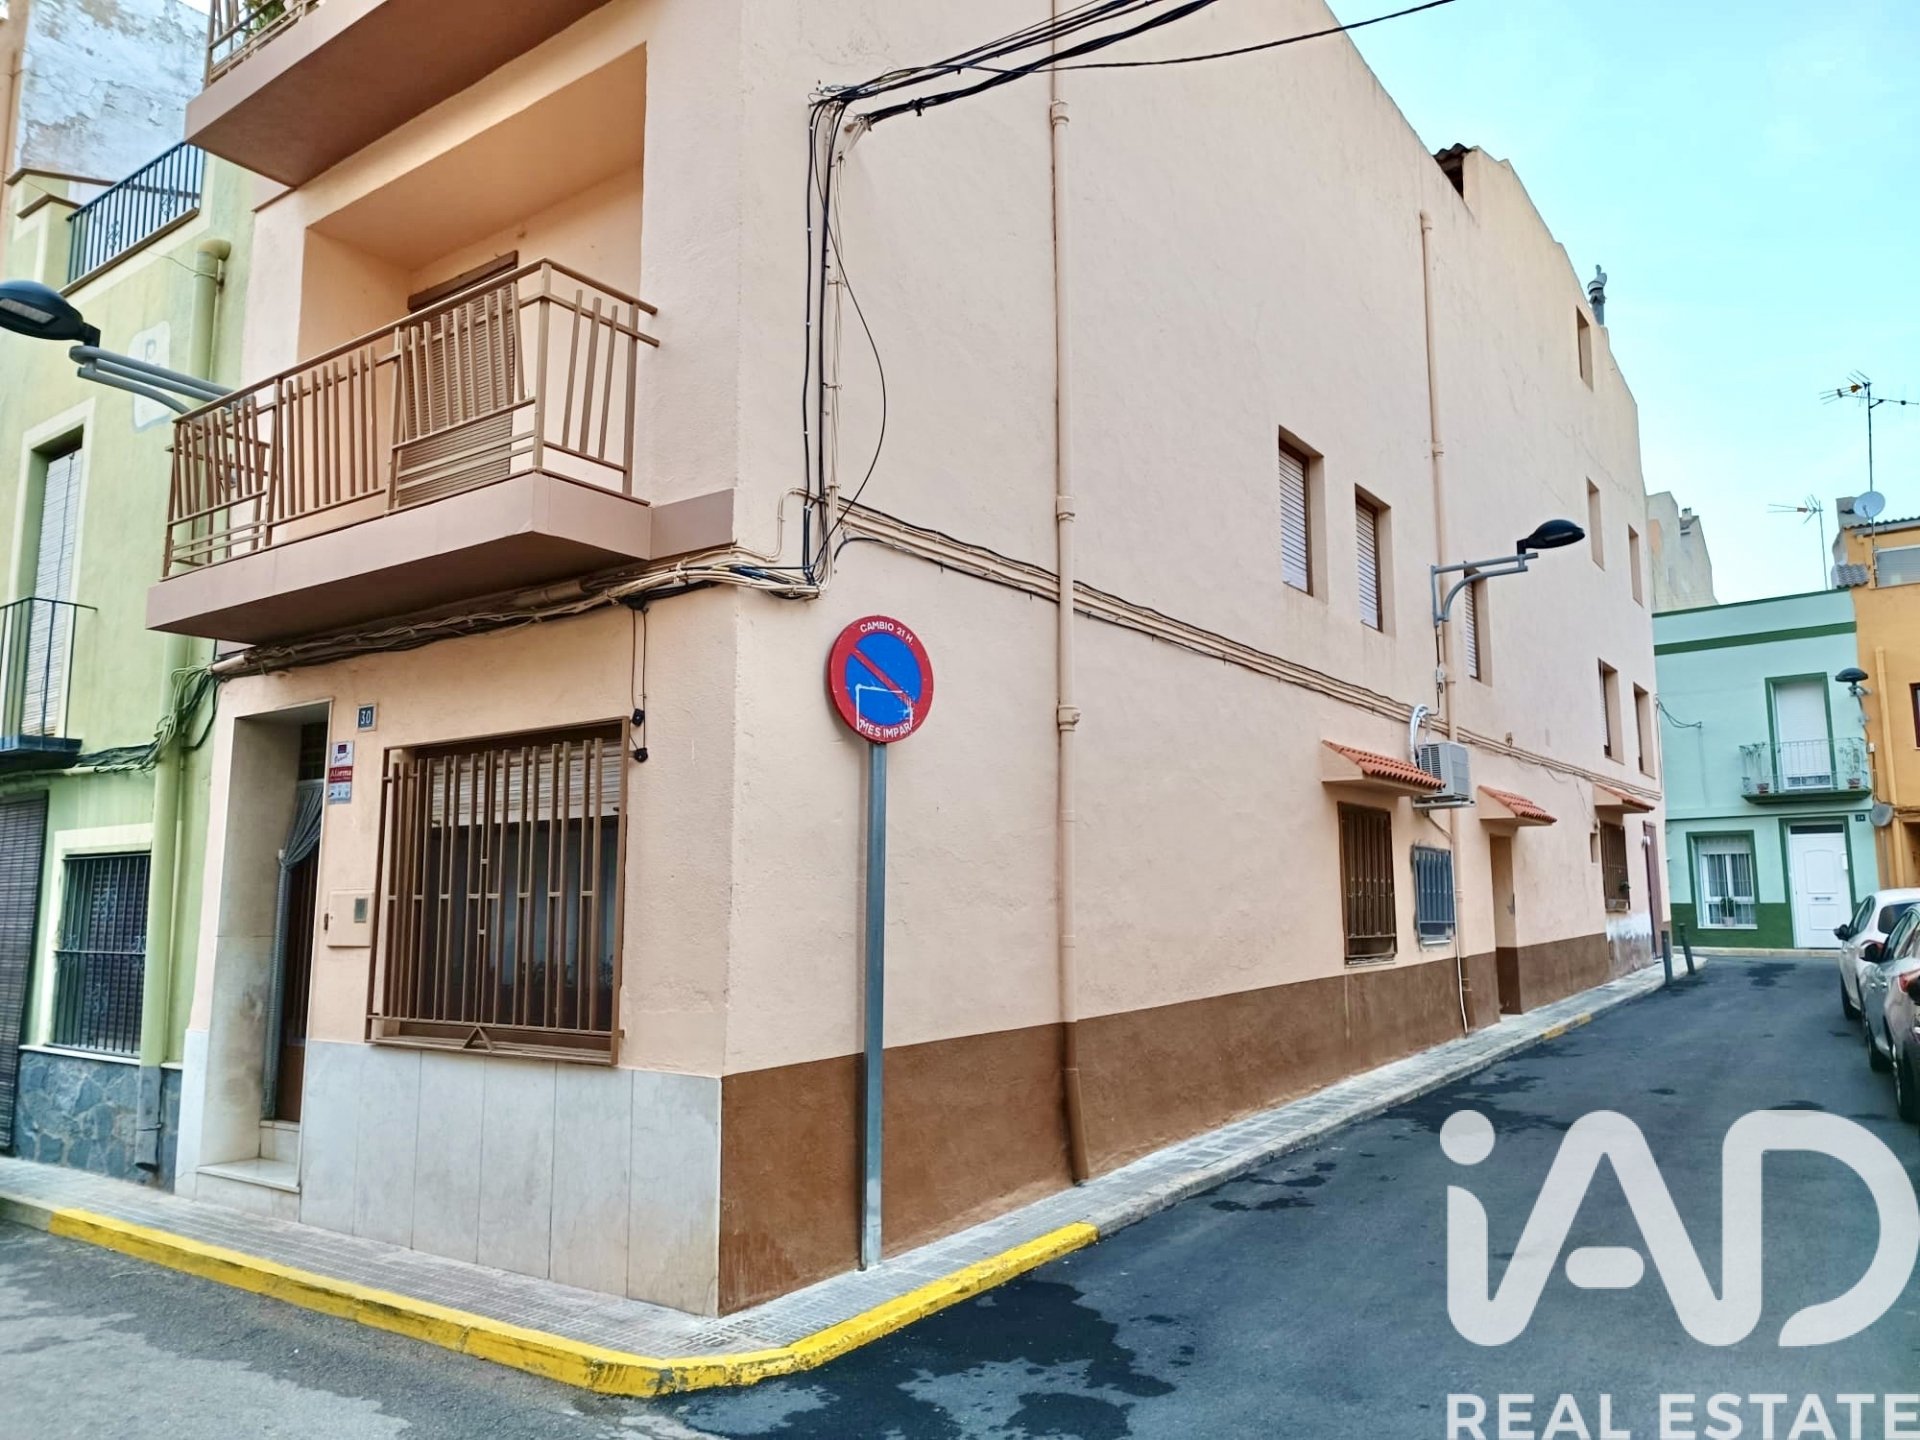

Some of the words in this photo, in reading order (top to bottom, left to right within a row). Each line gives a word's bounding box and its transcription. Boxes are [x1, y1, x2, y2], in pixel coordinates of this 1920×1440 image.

[860, 621, 894, 632] CAMBIO
[896, 627, 906, 637] 21
[360, 711, 371, 724] 30
[860, 720, 881, 736] MES
[883, 722, 911, 738] IMPAR
